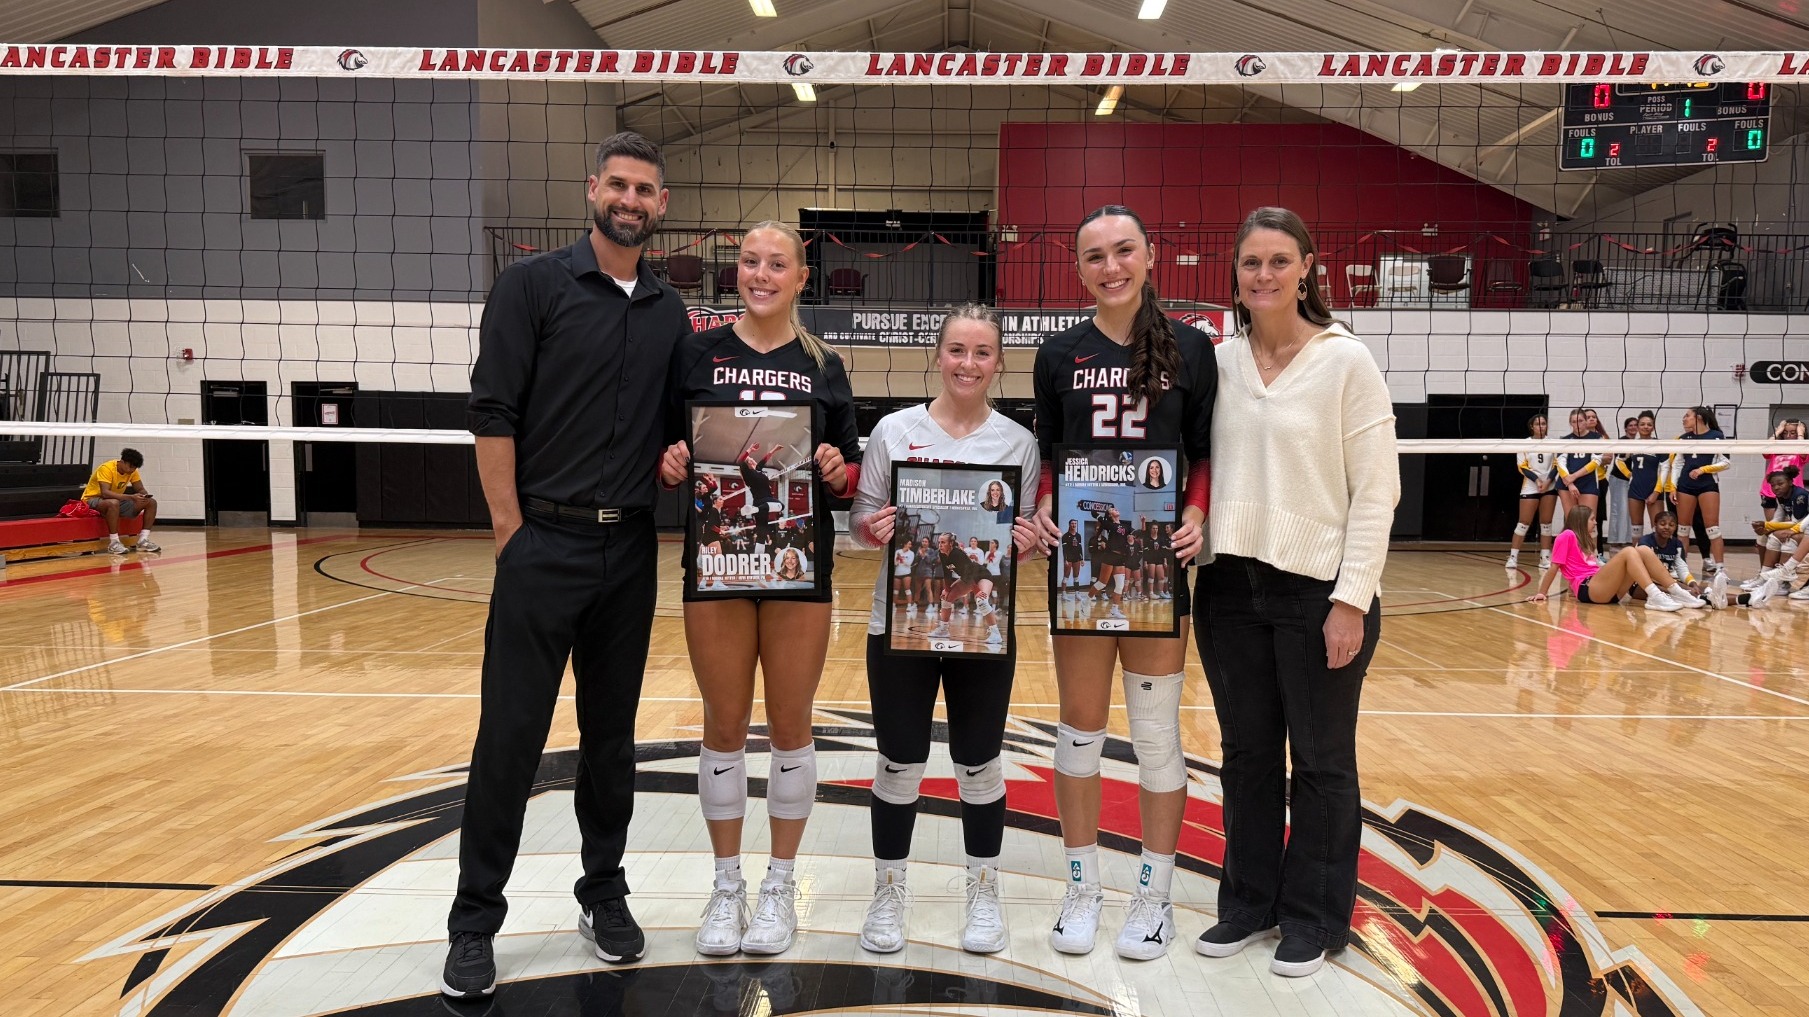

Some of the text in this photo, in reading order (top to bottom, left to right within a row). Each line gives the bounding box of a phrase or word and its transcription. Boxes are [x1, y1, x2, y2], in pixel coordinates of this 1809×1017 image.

[189, 47, 294, 70] BIBLE
[418, 50, 740, 75] LANCASTER BIBLE
[865, 54, 1191, 76] LANCASTER BIBLE
[1317, 53, 1650, 76] LANCASTER BIBLE
[1594, 83, 1611, 109] 0
[1647, 95, 1666, 103] POSS
[1639, 103, 1673, 113] PERIOD
[1684, 98, 1692, 118] 1
[1717, 105, 1748, 115] BONUS
[1584, 113, 1615, 122] BONUS
[1734, 119, 1764, 129] FOULS
[1568, 128, 1597, 138] FOULS
[1630, 125, 1663, 135] PLAYER
[1678, 122, 1707, 132] FOULS
[1706, 138, 1718, 152] 2
[1747, 130, 1762, 149] 0
[1580, 138, 1594, 158] 0
[1609, 143, 1621, 157] 2
[1605, 157, 1622, 166] TOL
[1702, 153, 1719, 162] TOL
[852, 313, 908, 330] PURSUE
[823, 332, 838, 340] AND
[713, 367, 812, 394] CHARGERS
[1091, 393, 1148, 440] 22
[1065, 457, 1089, 466] JESSICA
[1537, 453, 1544, 464] 9
[1636, 456, 1644, 469] 7
[1065, 464, 1136, 482] HENDRICKS
[899, 478, 927, 487] MADISON
[899, 487, 976, 506] TIMBERLAKE
[701, 546, 718, 554] RILEY
[701, 553, 772, 576] DODRER
